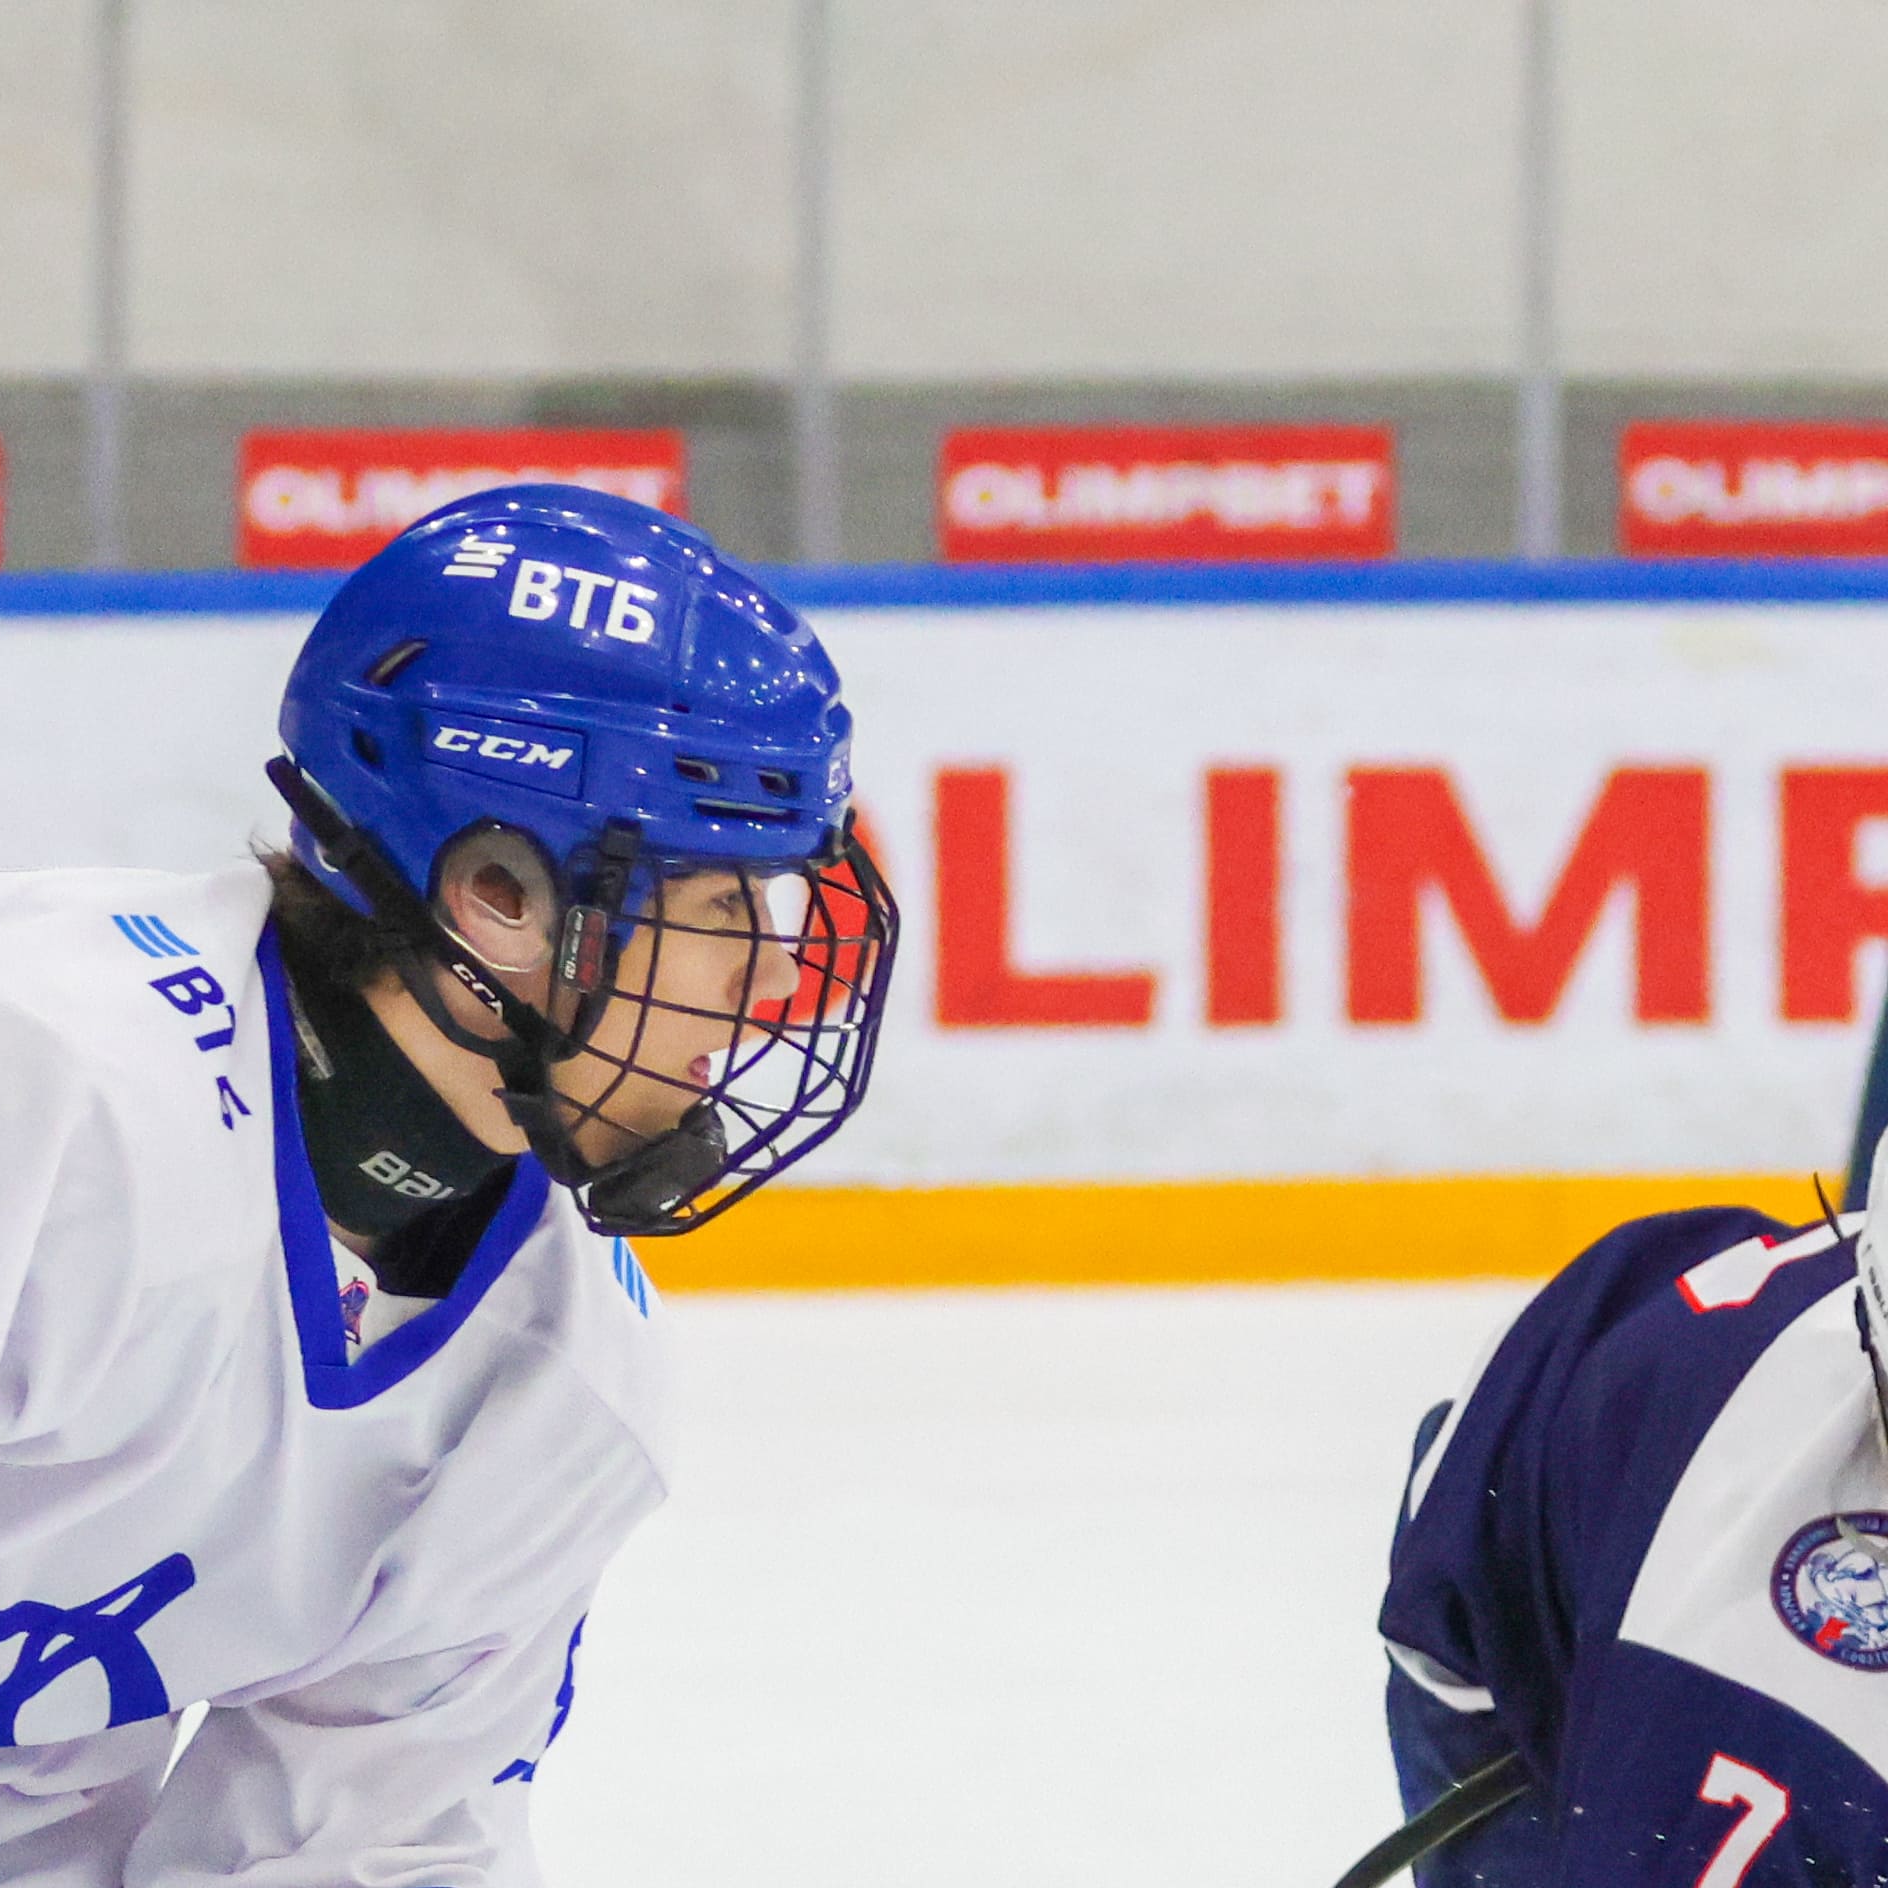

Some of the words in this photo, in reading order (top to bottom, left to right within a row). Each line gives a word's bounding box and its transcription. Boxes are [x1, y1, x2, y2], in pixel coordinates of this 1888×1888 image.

[948, 462, 1382, 530] OLIMPBET
[508, 559, 658, 643] ВТБ
[432, 726, 573, 771] CCM
